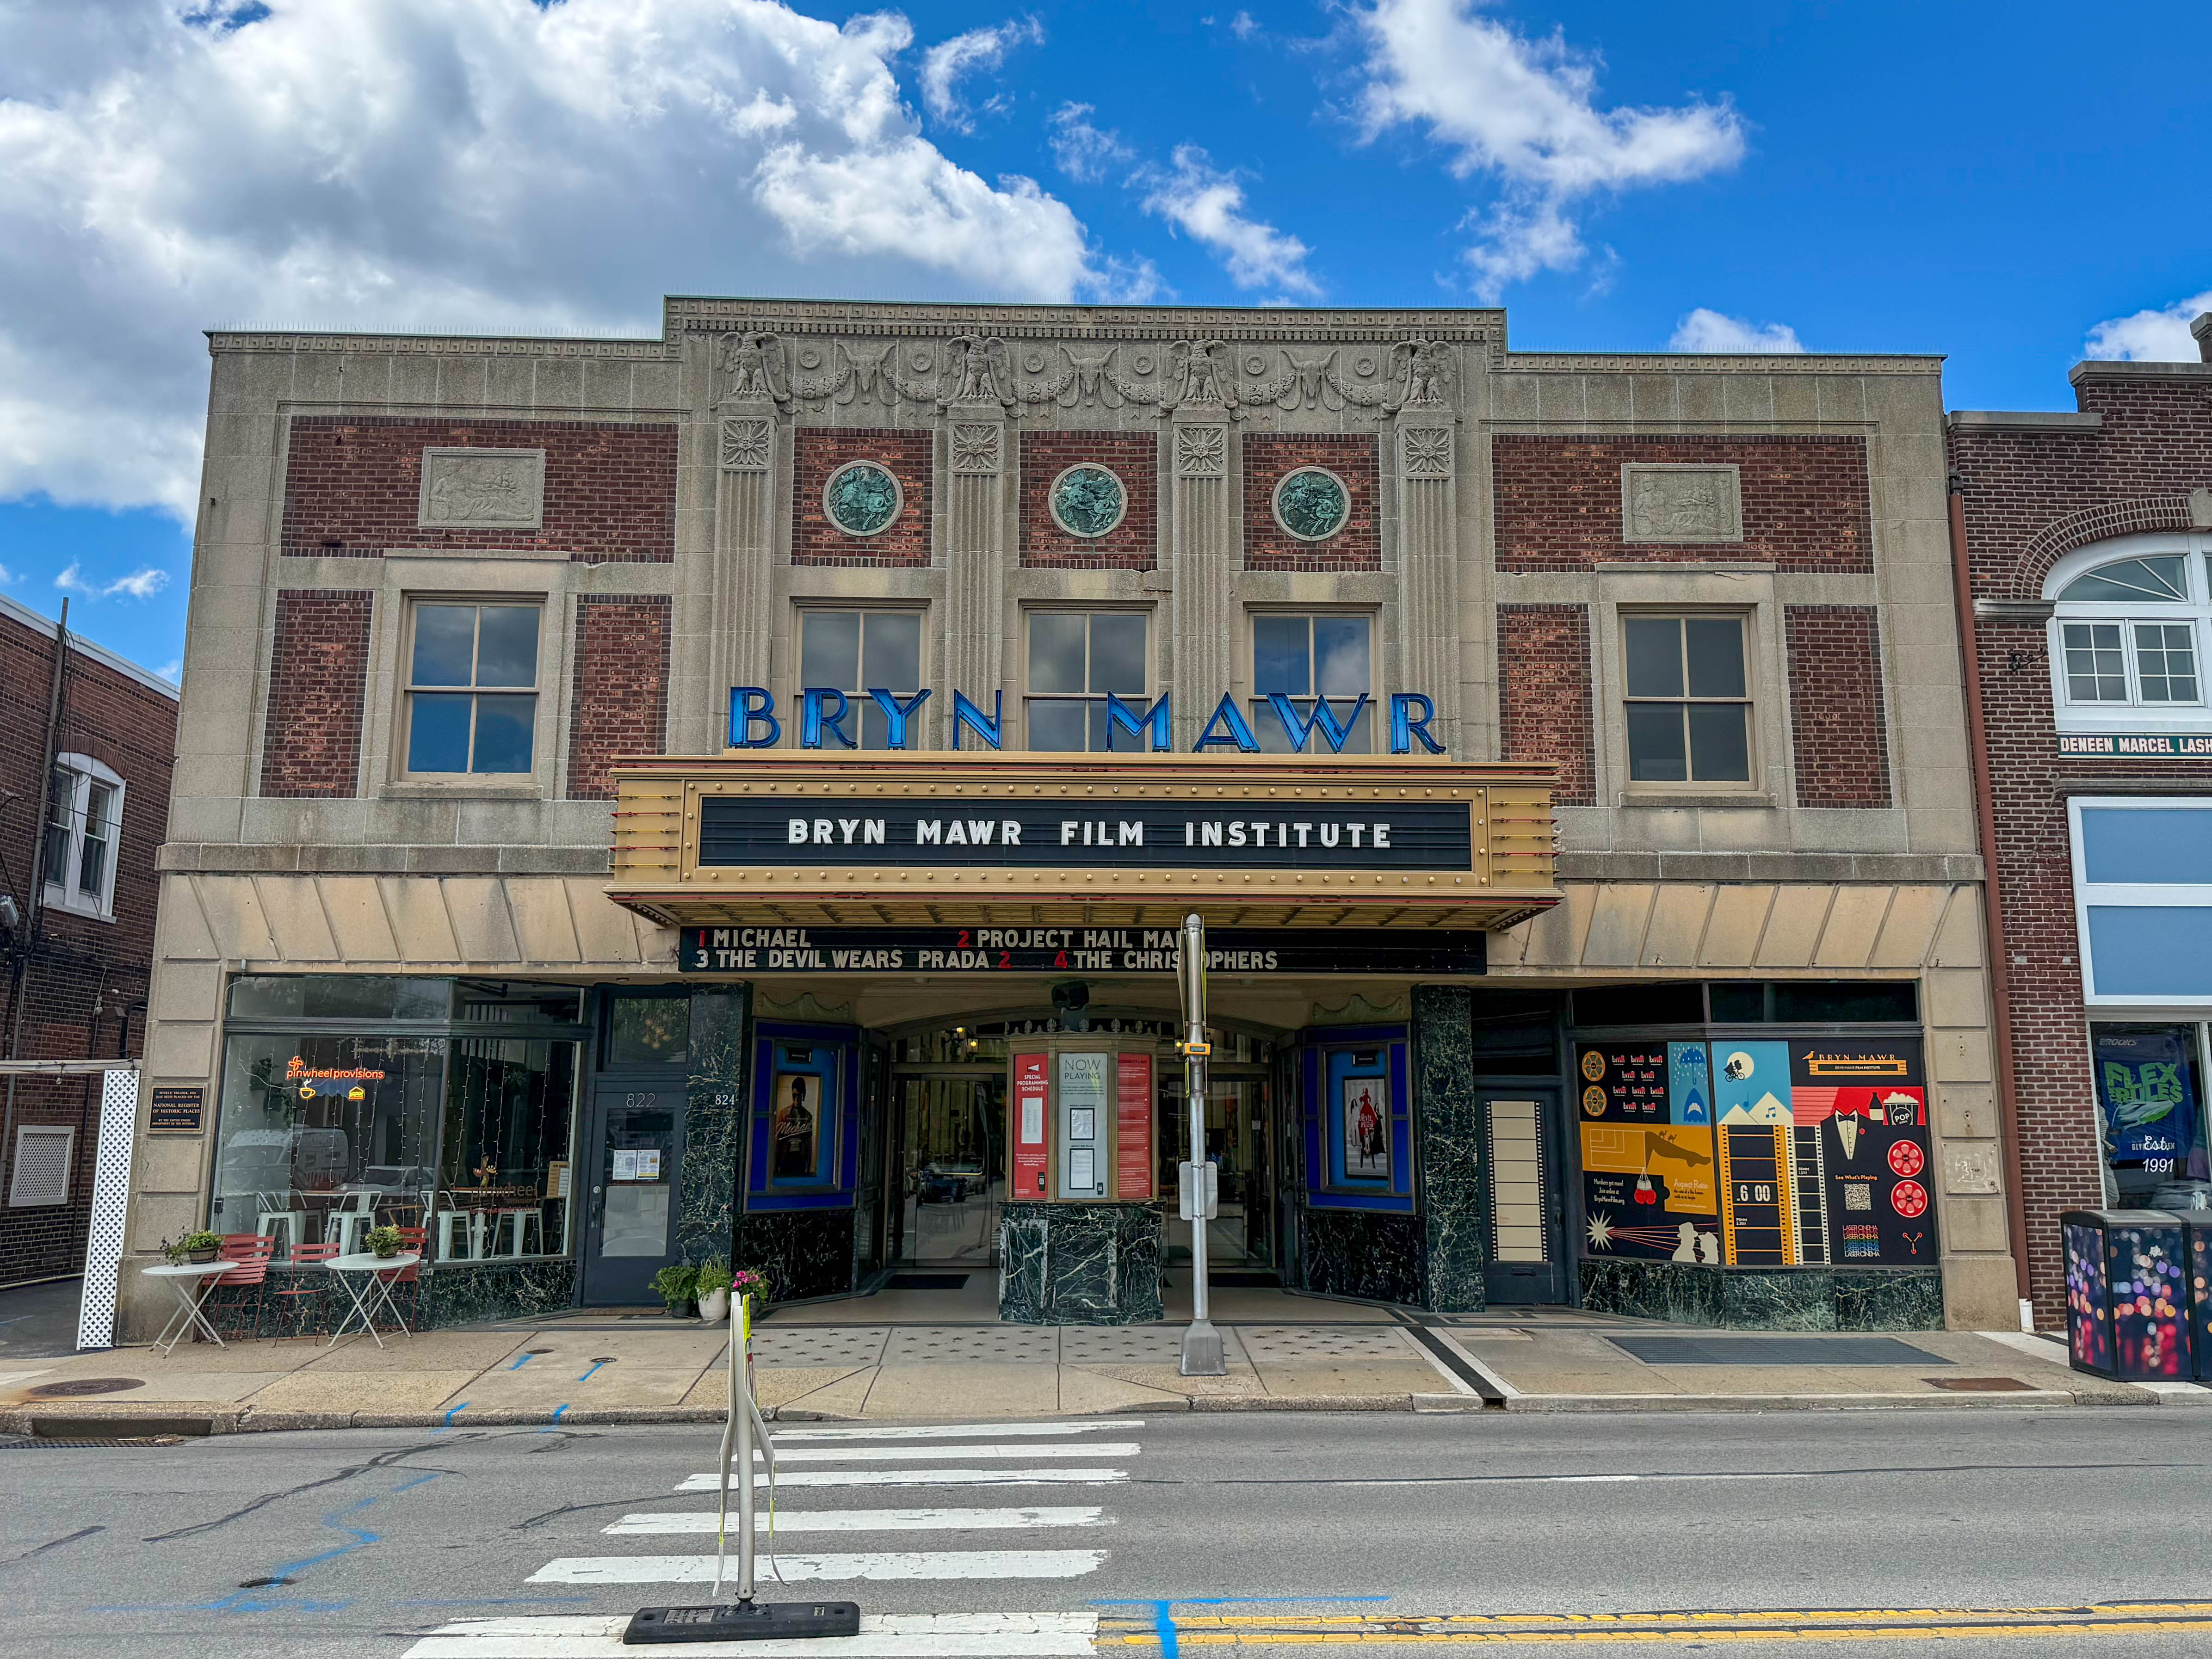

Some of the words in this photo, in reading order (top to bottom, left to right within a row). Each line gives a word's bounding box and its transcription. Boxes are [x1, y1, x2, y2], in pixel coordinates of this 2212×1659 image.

[729, 686, 1001, 751] BRYN
[1106, 689, 1447, 754] MAWR
[2060, 737, 2113, 752] DENEEN
[2119, 738, 2174, 752] MARCEL
[788, 819, 886, 845] BRYN
[916, 820, 1022, 846] MAWR
[1060, 820, 1144, 847] FILM
[1185, 821, 1391, 848] INSTITUTE
[713, 928, 811, 948] MICHAEL
[957, 931, 970, 948] 2
[977, 930, 1073, 948] PROJECT
[1084, 930, 1133, 949] HAIL
[1143, 931, 1181, 949] MA
[696, 950, 709, 968] 3
[716, 950, 756, 968] THE
[769, 950, 827, 968] DEVIL
[833, 950, 902, 968] WEARS
[918, 950, 989, 969] PRADA
[998, 951, 1011, 969] 2
[1054, 950, 1068, 968] 4
[1073, 950, 1112, 969] THE
[1124, 951, 1278, 970] CHRISPHERS
[1065, 1059, 1101, 1070] NOW
[286, 1068, 333, 1079] pinwheel
[334, 1068, 383, 1079] provisions
[2104, 1061, 2181, 1089] FLEX
[626, 1093, 656, 1107] 822
[715, 1094, 735, 1105] 824
[2114, 1083, 2183, 1104] RULES
[1895, 1113, 1910, 1122] POP
[2144, 1135, 2169, 1151] Est.
[2143, 1158, 2174, 1172] 1991
[1674, 1178, 1693, 1189] Aspect
[1693, 1179, 1708, 1189] Ratio
[1594, 1195, 1625, 1205] BrynMawrFilm.org
[1755, 1184, 1771, 1202] 00
